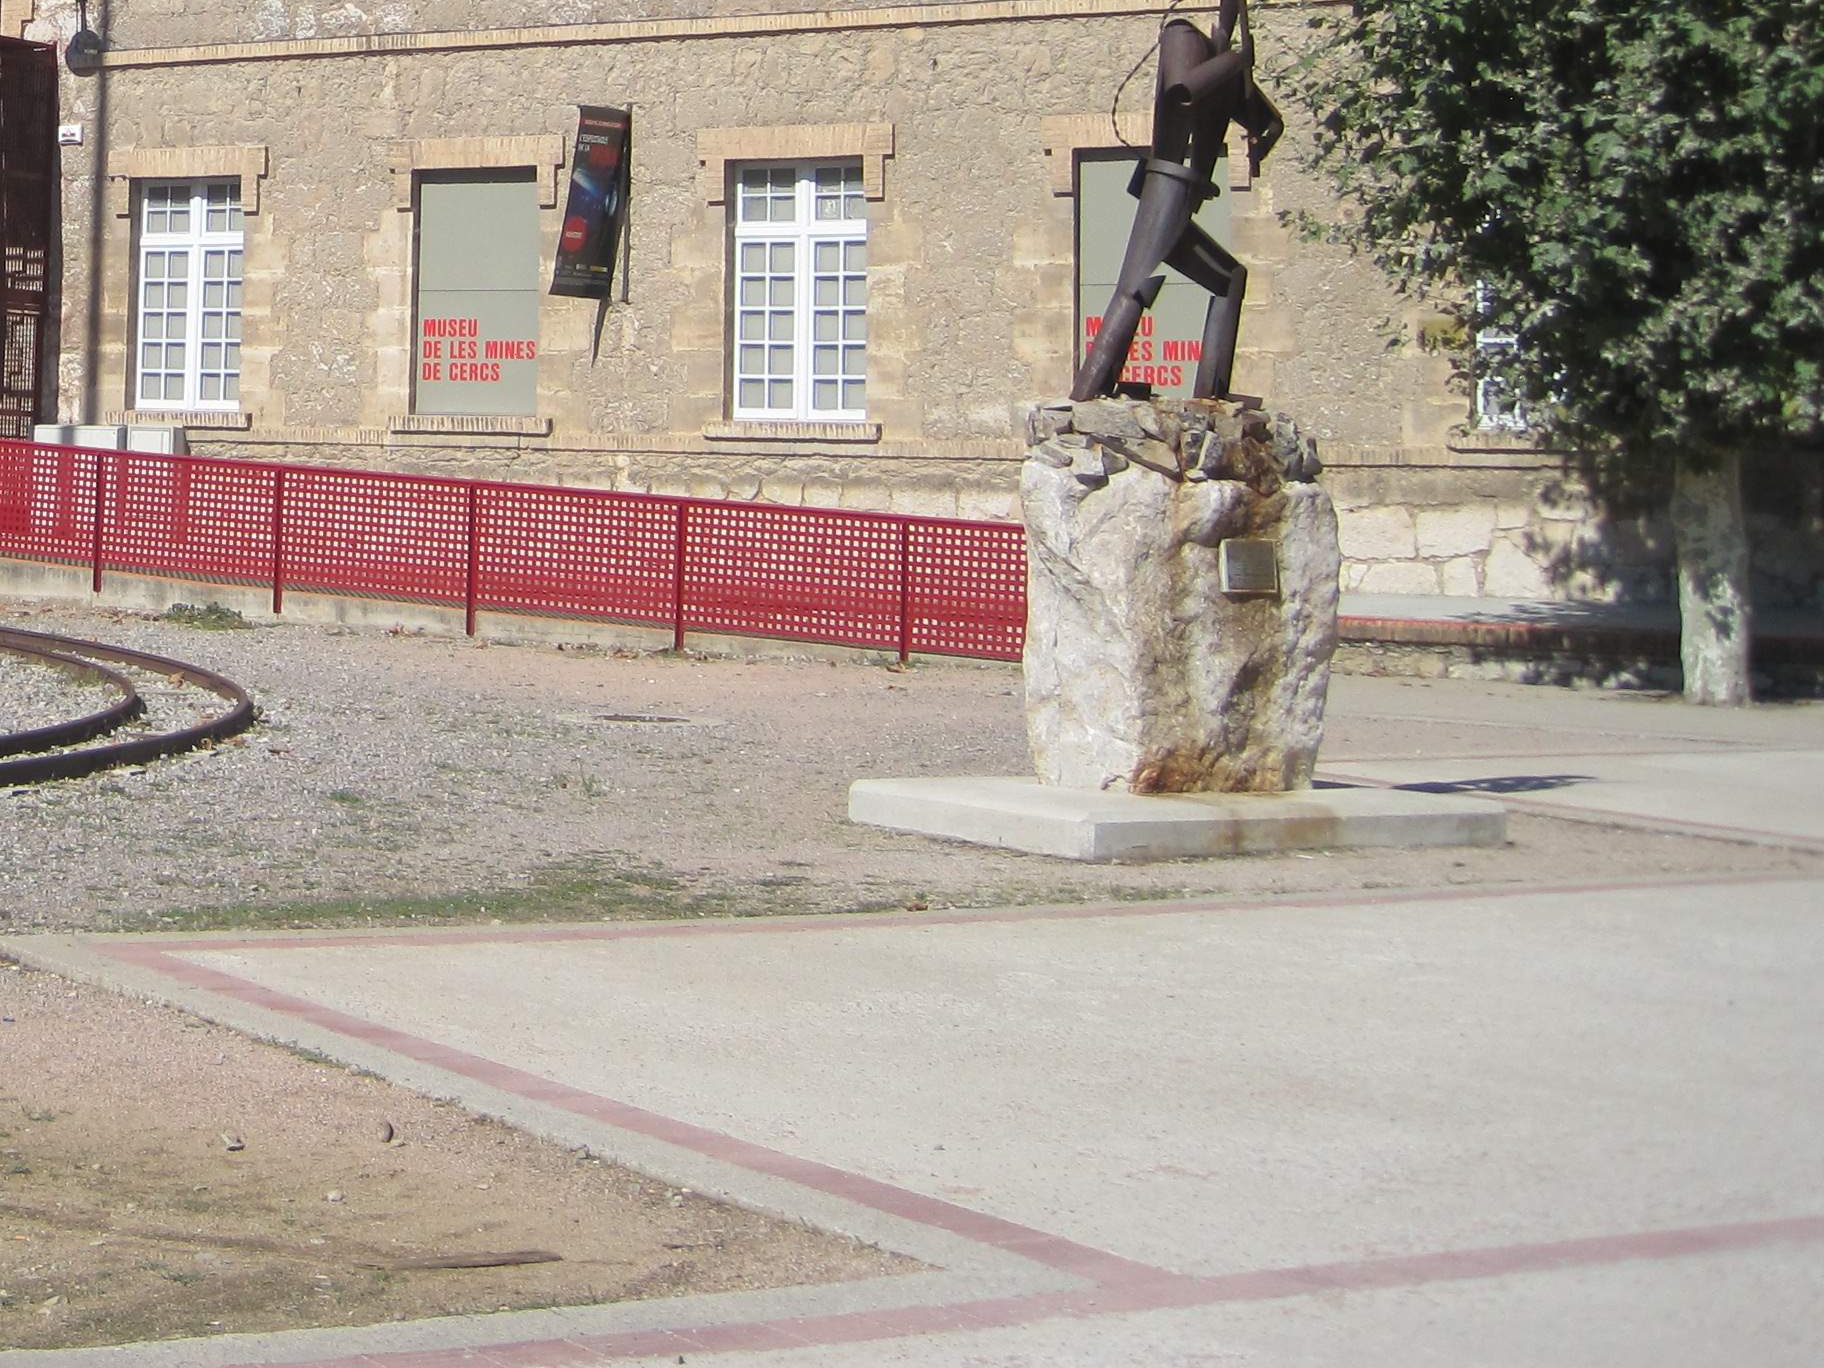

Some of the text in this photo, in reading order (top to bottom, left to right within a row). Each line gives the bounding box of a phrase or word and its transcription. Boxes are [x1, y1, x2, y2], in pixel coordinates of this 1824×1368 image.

[423, 318, 479, 338] MUSEU
[422, 339, 536, 360] DE LES MINES
[422, 362, 501, 381] DE CERCS
